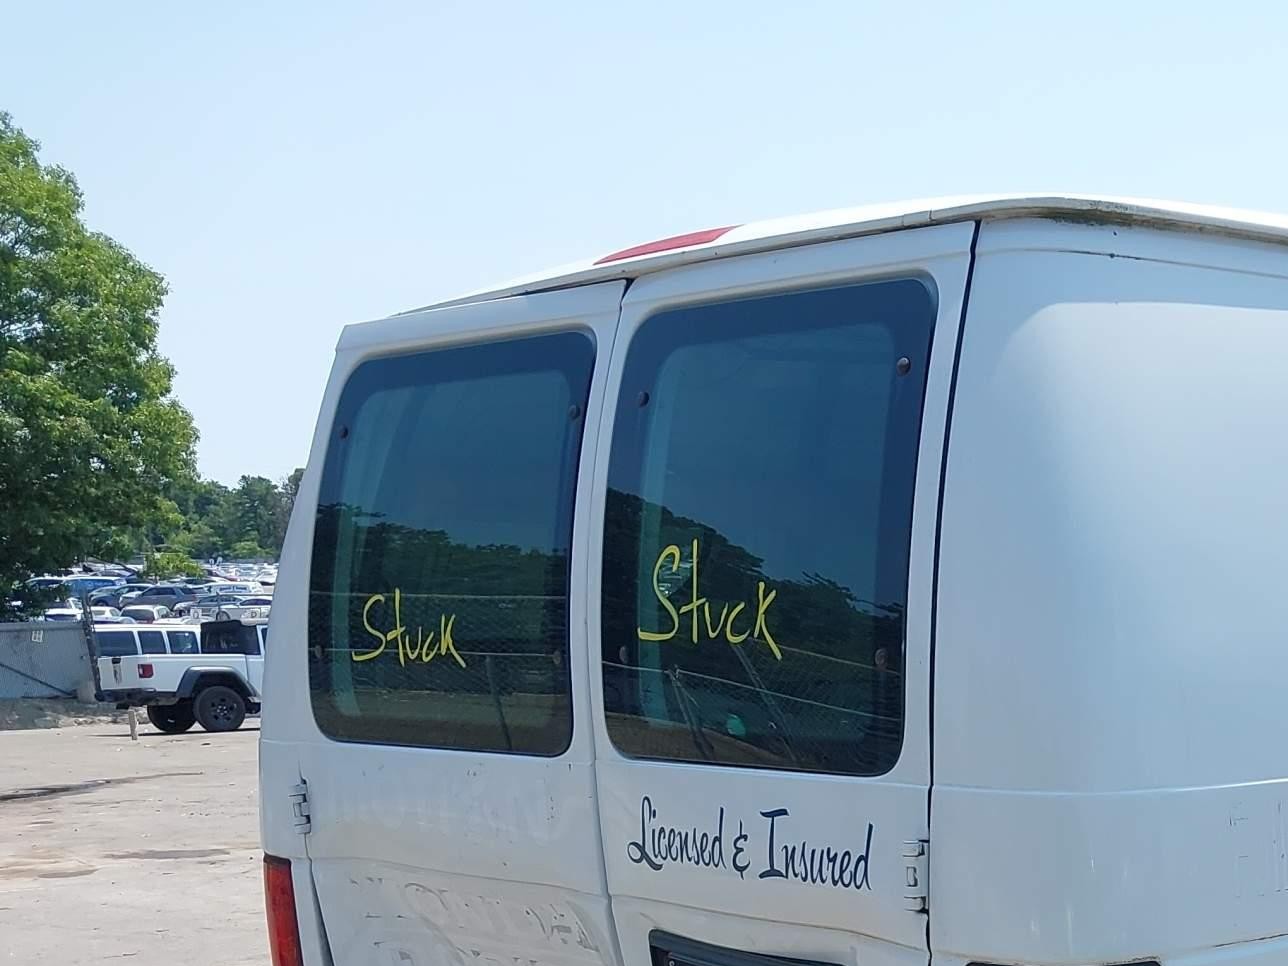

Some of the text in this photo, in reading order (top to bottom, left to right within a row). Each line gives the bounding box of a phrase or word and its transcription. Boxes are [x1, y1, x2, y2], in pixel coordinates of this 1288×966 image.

[626, 795, 874, 891] Licensed & Insured
